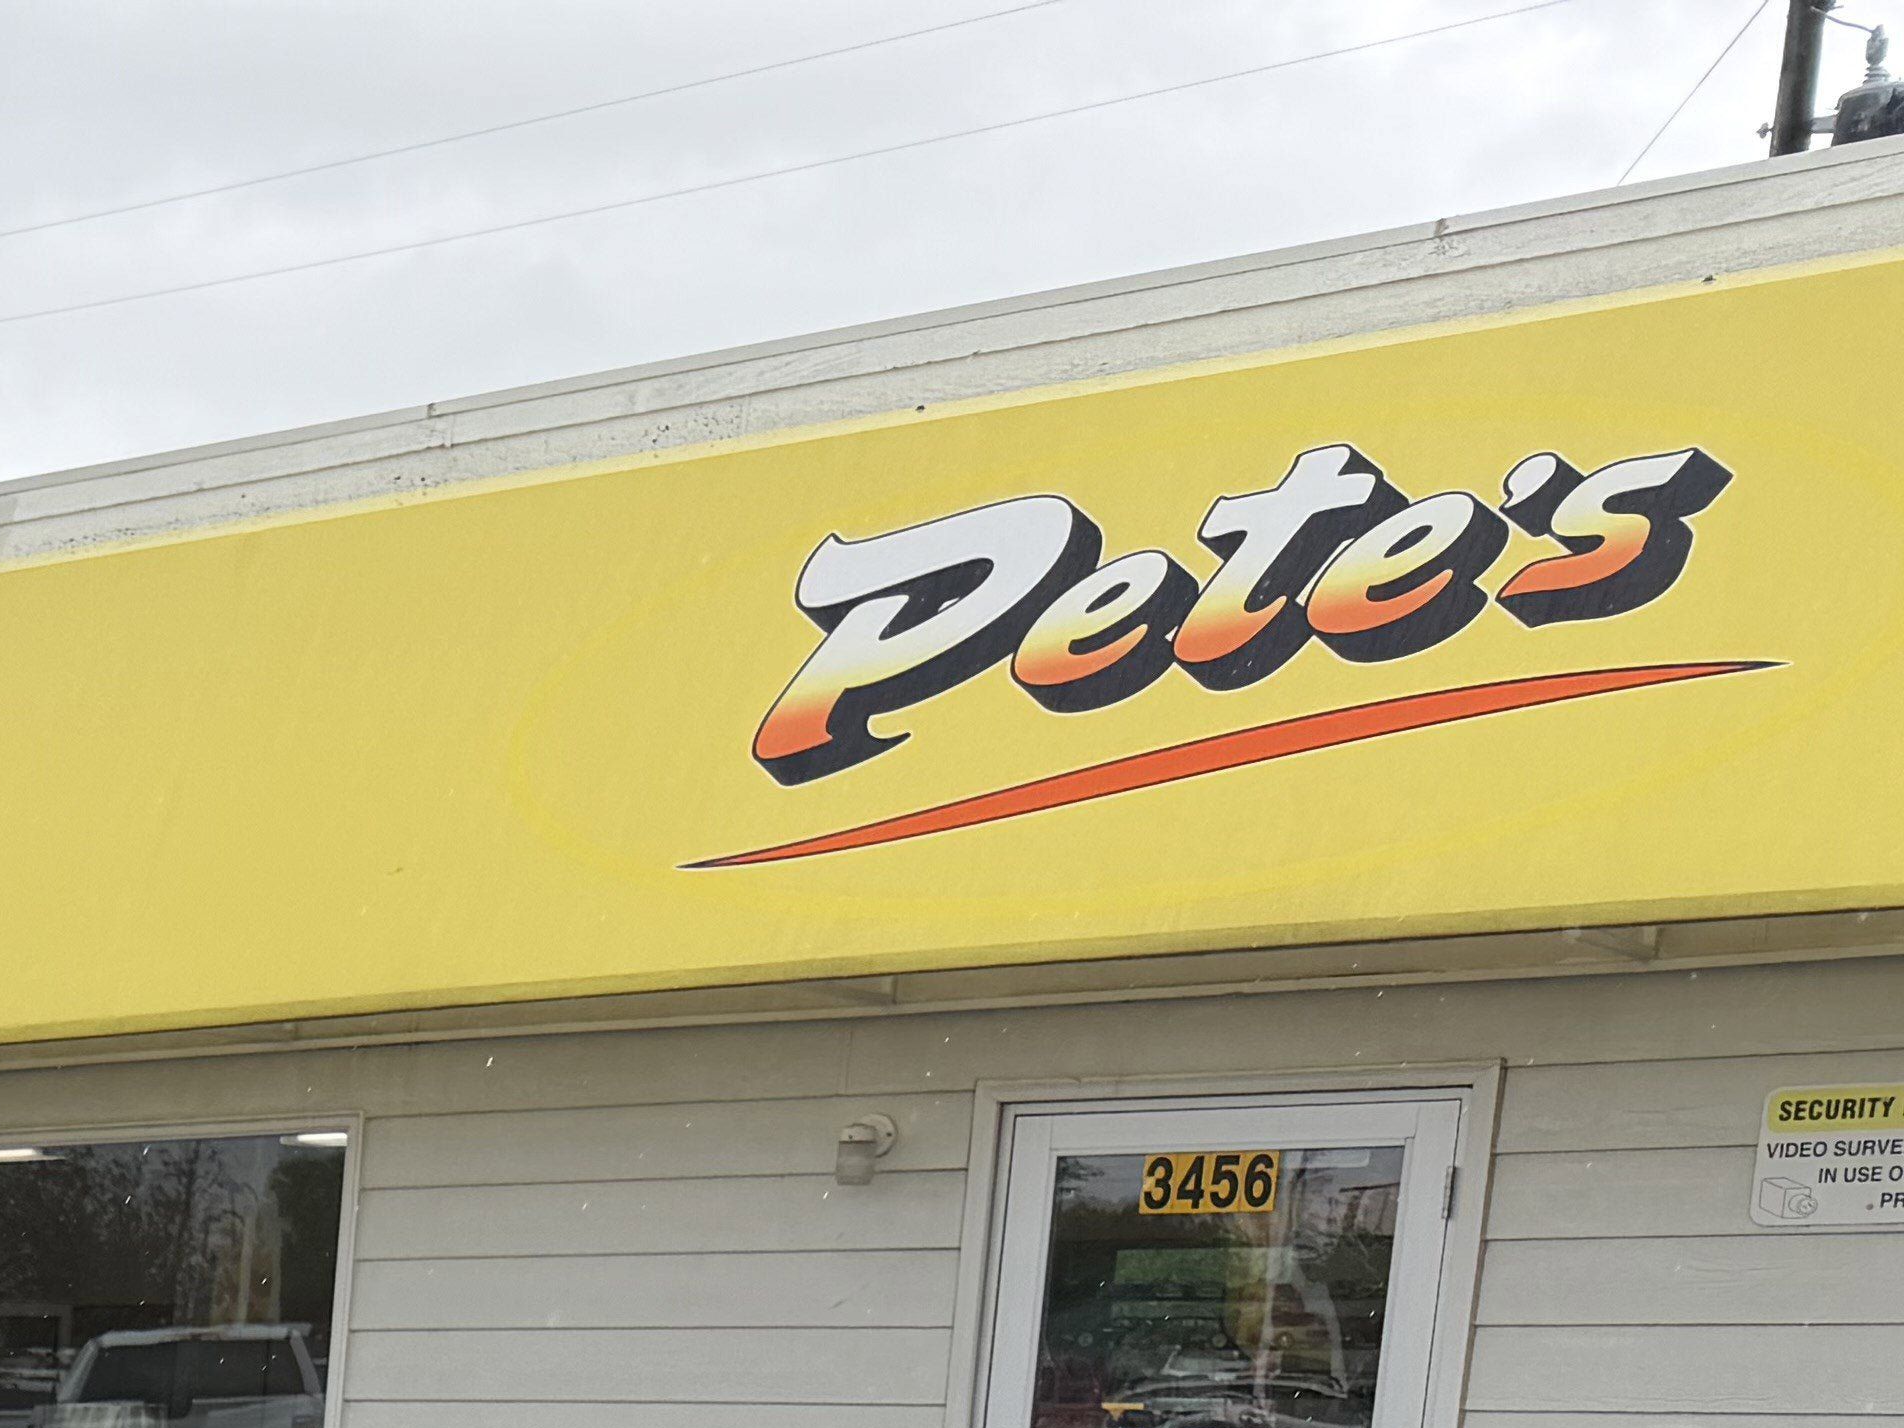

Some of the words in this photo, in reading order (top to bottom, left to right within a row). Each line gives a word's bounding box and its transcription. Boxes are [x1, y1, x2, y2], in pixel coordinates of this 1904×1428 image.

[751, 443, 1733, 786] Pete's
[1779, 1096, 1895, 1122] SECURITY
[1767, 1141, 1827, 1159] VIDEO
[1142, 1153, 1276, 1210] 3456
[1818, 1167, 1838, 1184] IN
[1844, 1166, 1883, 1183] USE
